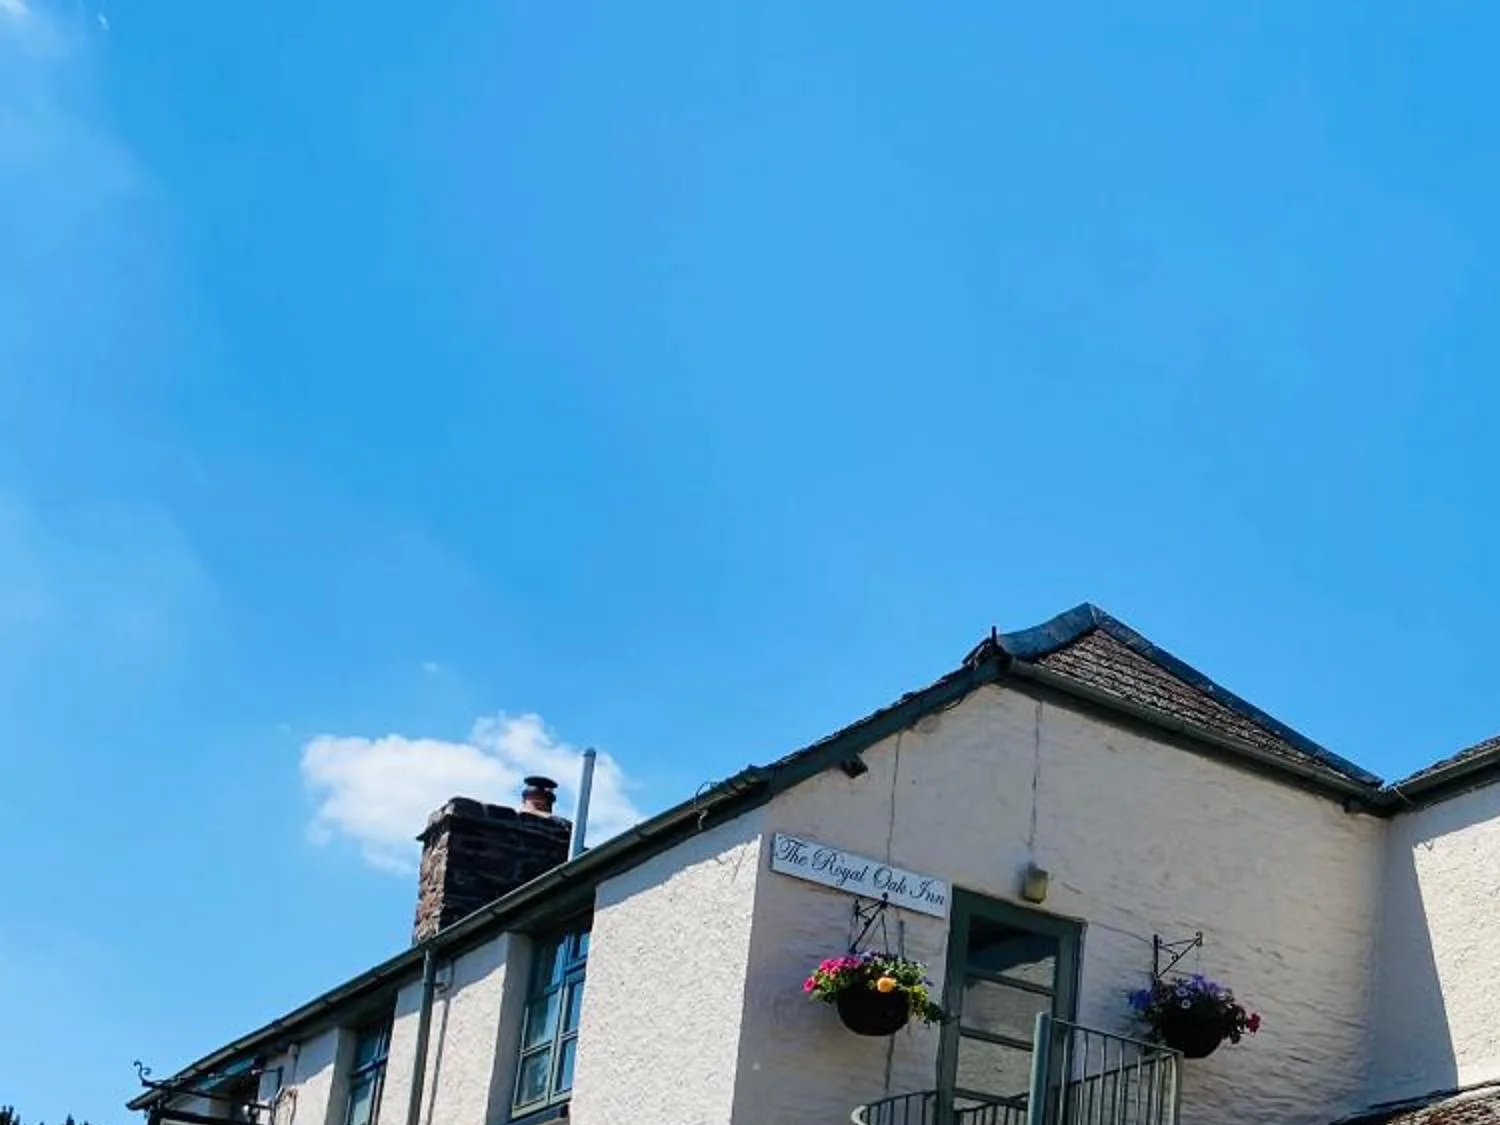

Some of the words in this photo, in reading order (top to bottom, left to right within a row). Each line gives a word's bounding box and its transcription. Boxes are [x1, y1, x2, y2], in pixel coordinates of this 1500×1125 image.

[776, 836, 808, 866] The
[811, 848, 869, 887] Royal
[873, 867, 907, 894] Oak
[909, 880, 945, 905] Inn
